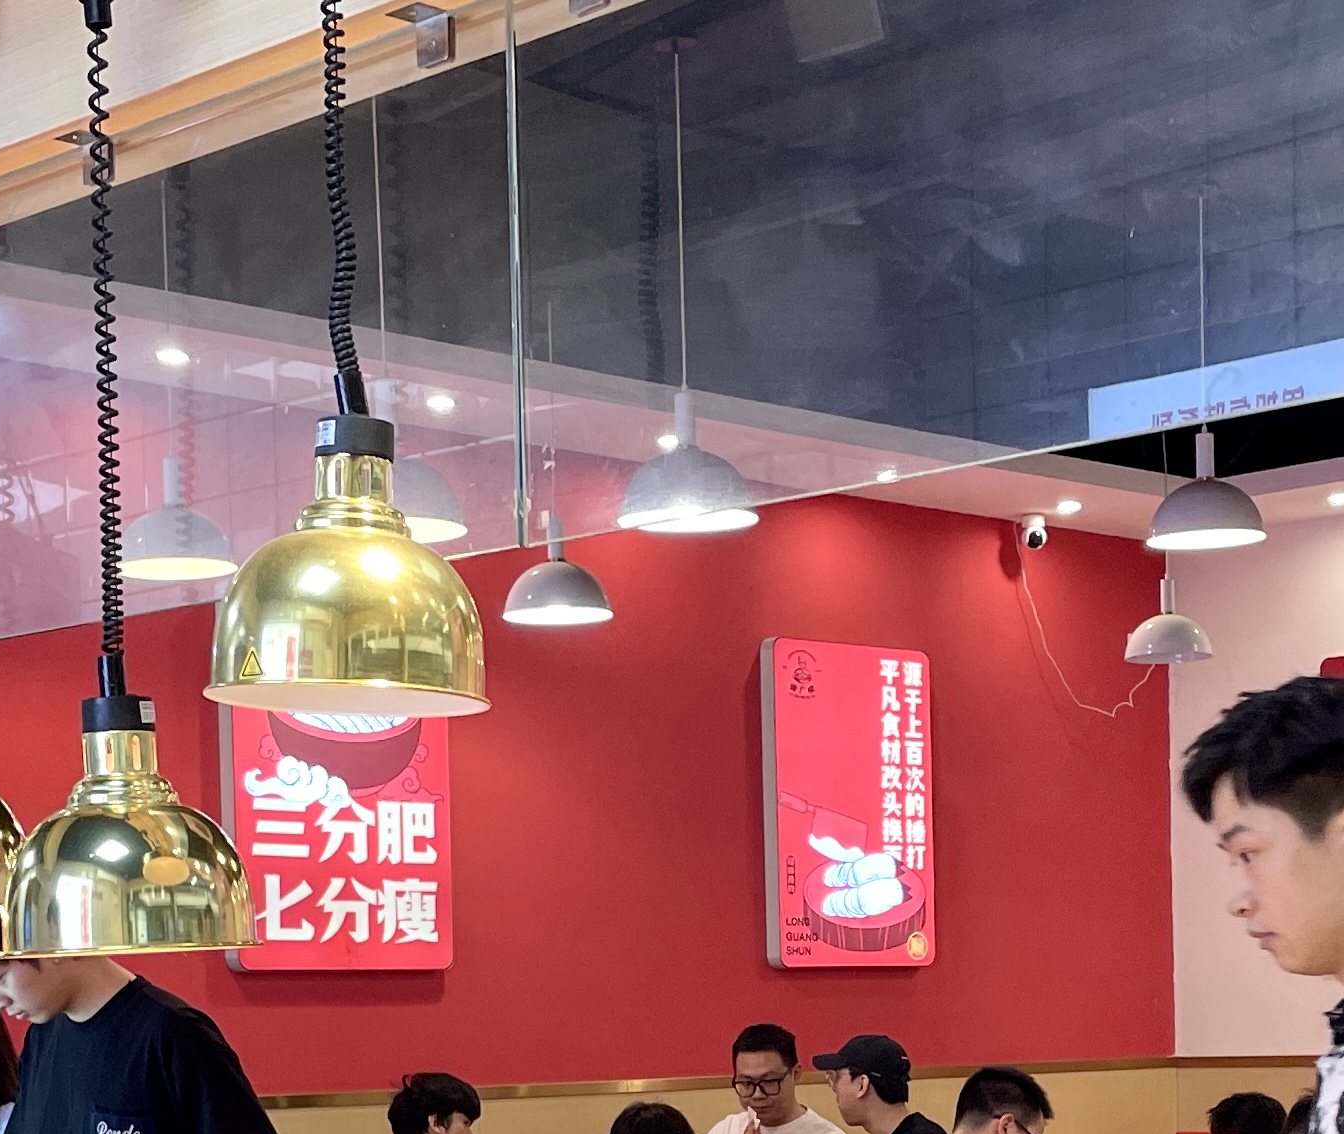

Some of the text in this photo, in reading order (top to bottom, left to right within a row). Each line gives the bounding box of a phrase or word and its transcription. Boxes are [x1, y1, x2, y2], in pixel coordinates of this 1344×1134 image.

[902, 661, 926, 870] 源于上百次的捶打
[252, 799, 438, 865] 三分肥
[255, 874, 439, 944] 七分瘦
[785, 917, 811, 927] LONG
[785, 946, 812, 956] SHUN
